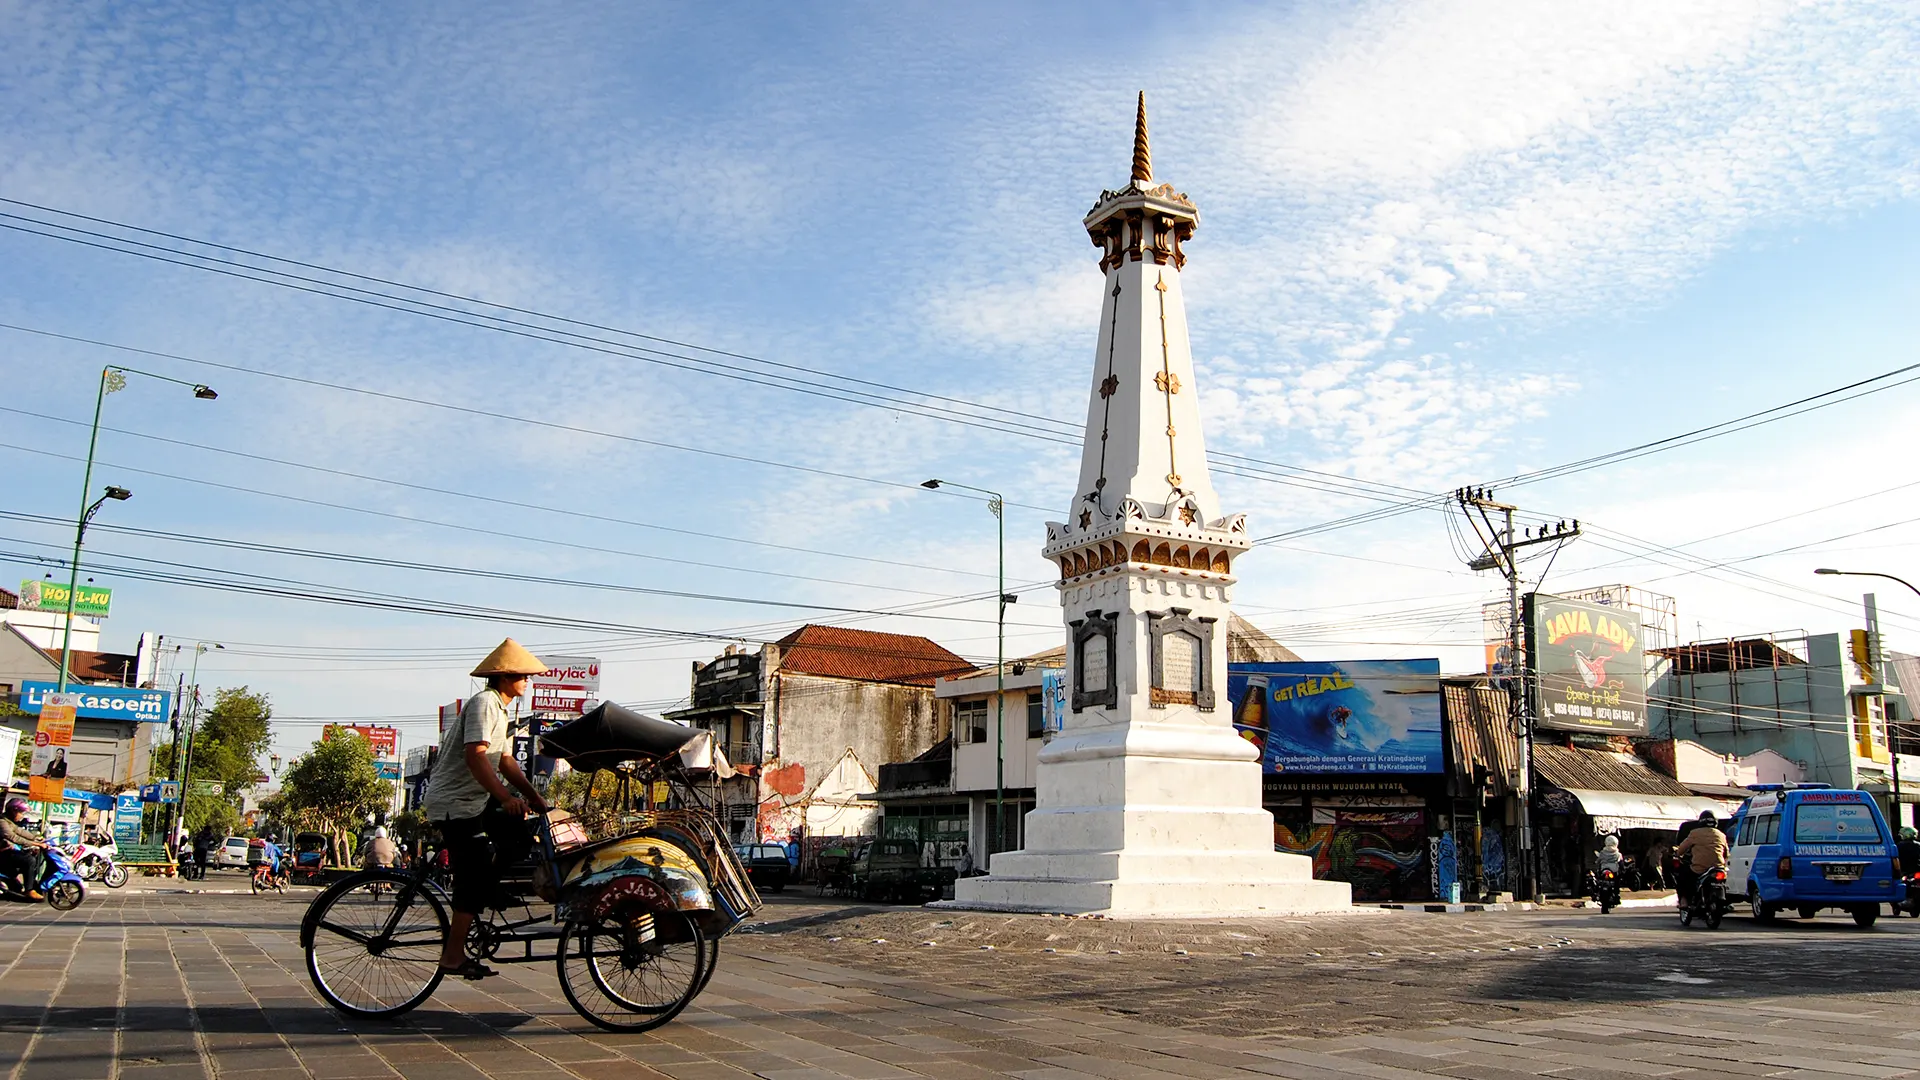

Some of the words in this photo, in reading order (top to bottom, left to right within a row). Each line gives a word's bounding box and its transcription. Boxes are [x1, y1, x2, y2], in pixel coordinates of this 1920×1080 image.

[1546, 611, 1592, 644] JAVA
[1596, 615, 1636, 653] ADV
[1274, 686, 1293, 702] GET
[535, 697, 576, 708] MAXILITE
[135, 712, 160, 720] Optikal
[516, 741, 528, 777] TOK
[1275, 755, 1321, 763] Bergabunglah
[1321, 755, 1346, 763] dengan
[1378, 754, 1427, 763] Kratingdaeng!
[1285, 764, 1354, 772] www.kratingdaeng.co.id
[1378, 764, 1427, 772] MyKratingdaeng
[1301, 783, 1330, 791] BERSIH
[1332, 783, 1376, 791] WUJUDKAN
[1378, 783, 1404, 791] NYATA
[1802, 793, 1861, 803] AMBULANCE
[1839, 808, 1857, 817] pkpu
[1794, 845, 1822, 855] LAYANAN
[1823, 845, 1857, 856] KESEHATAN
